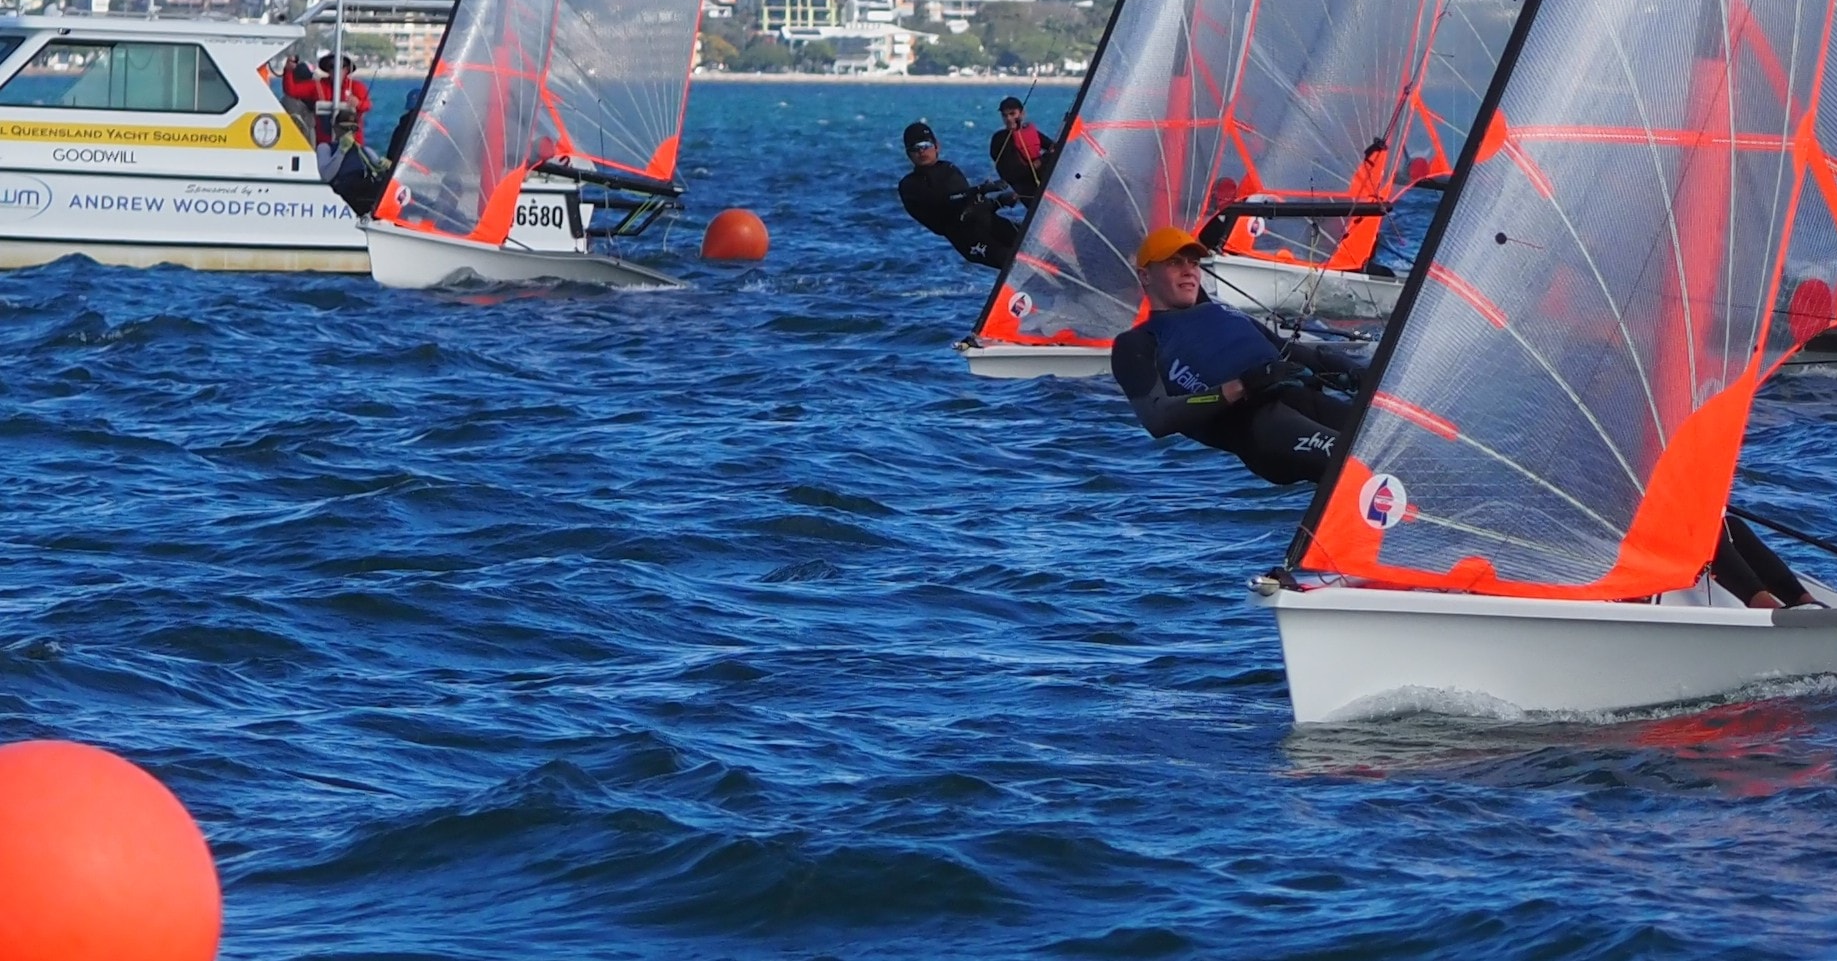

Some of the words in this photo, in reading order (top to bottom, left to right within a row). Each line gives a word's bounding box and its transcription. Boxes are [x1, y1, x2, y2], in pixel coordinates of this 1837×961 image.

[53, 148, 137, 164] GOODWILL
[69, 194, 165, 212] ANDREW
[173, 198, 313, 218] WOODFORTH
[323, 204, 353, 220] MA
[515, 205, 563, 229] 658Q
